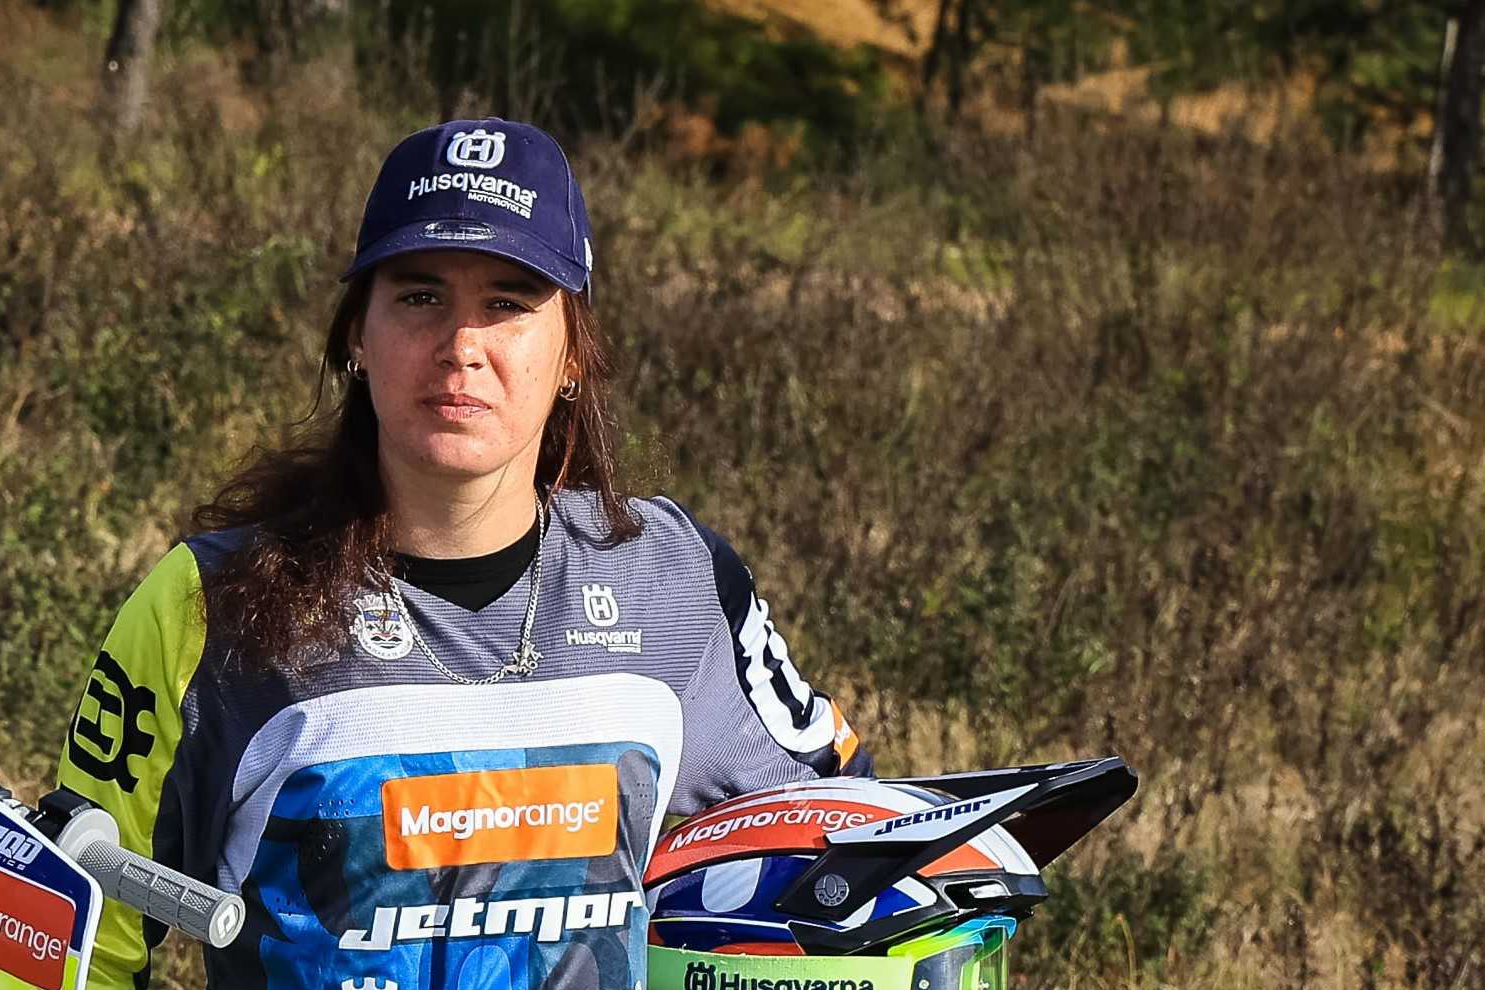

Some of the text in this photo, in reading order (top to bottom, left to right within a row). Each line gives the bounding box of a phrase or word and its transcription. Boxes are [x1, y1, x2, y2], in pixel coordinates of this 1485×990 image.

[408, 172, 537, 207] Husqvarna
[467, 192, 531, 219] MOTORCYCLES
[400, 800, 602, 841] Magnorange
[668, 804, 870, 853] Magnorange
